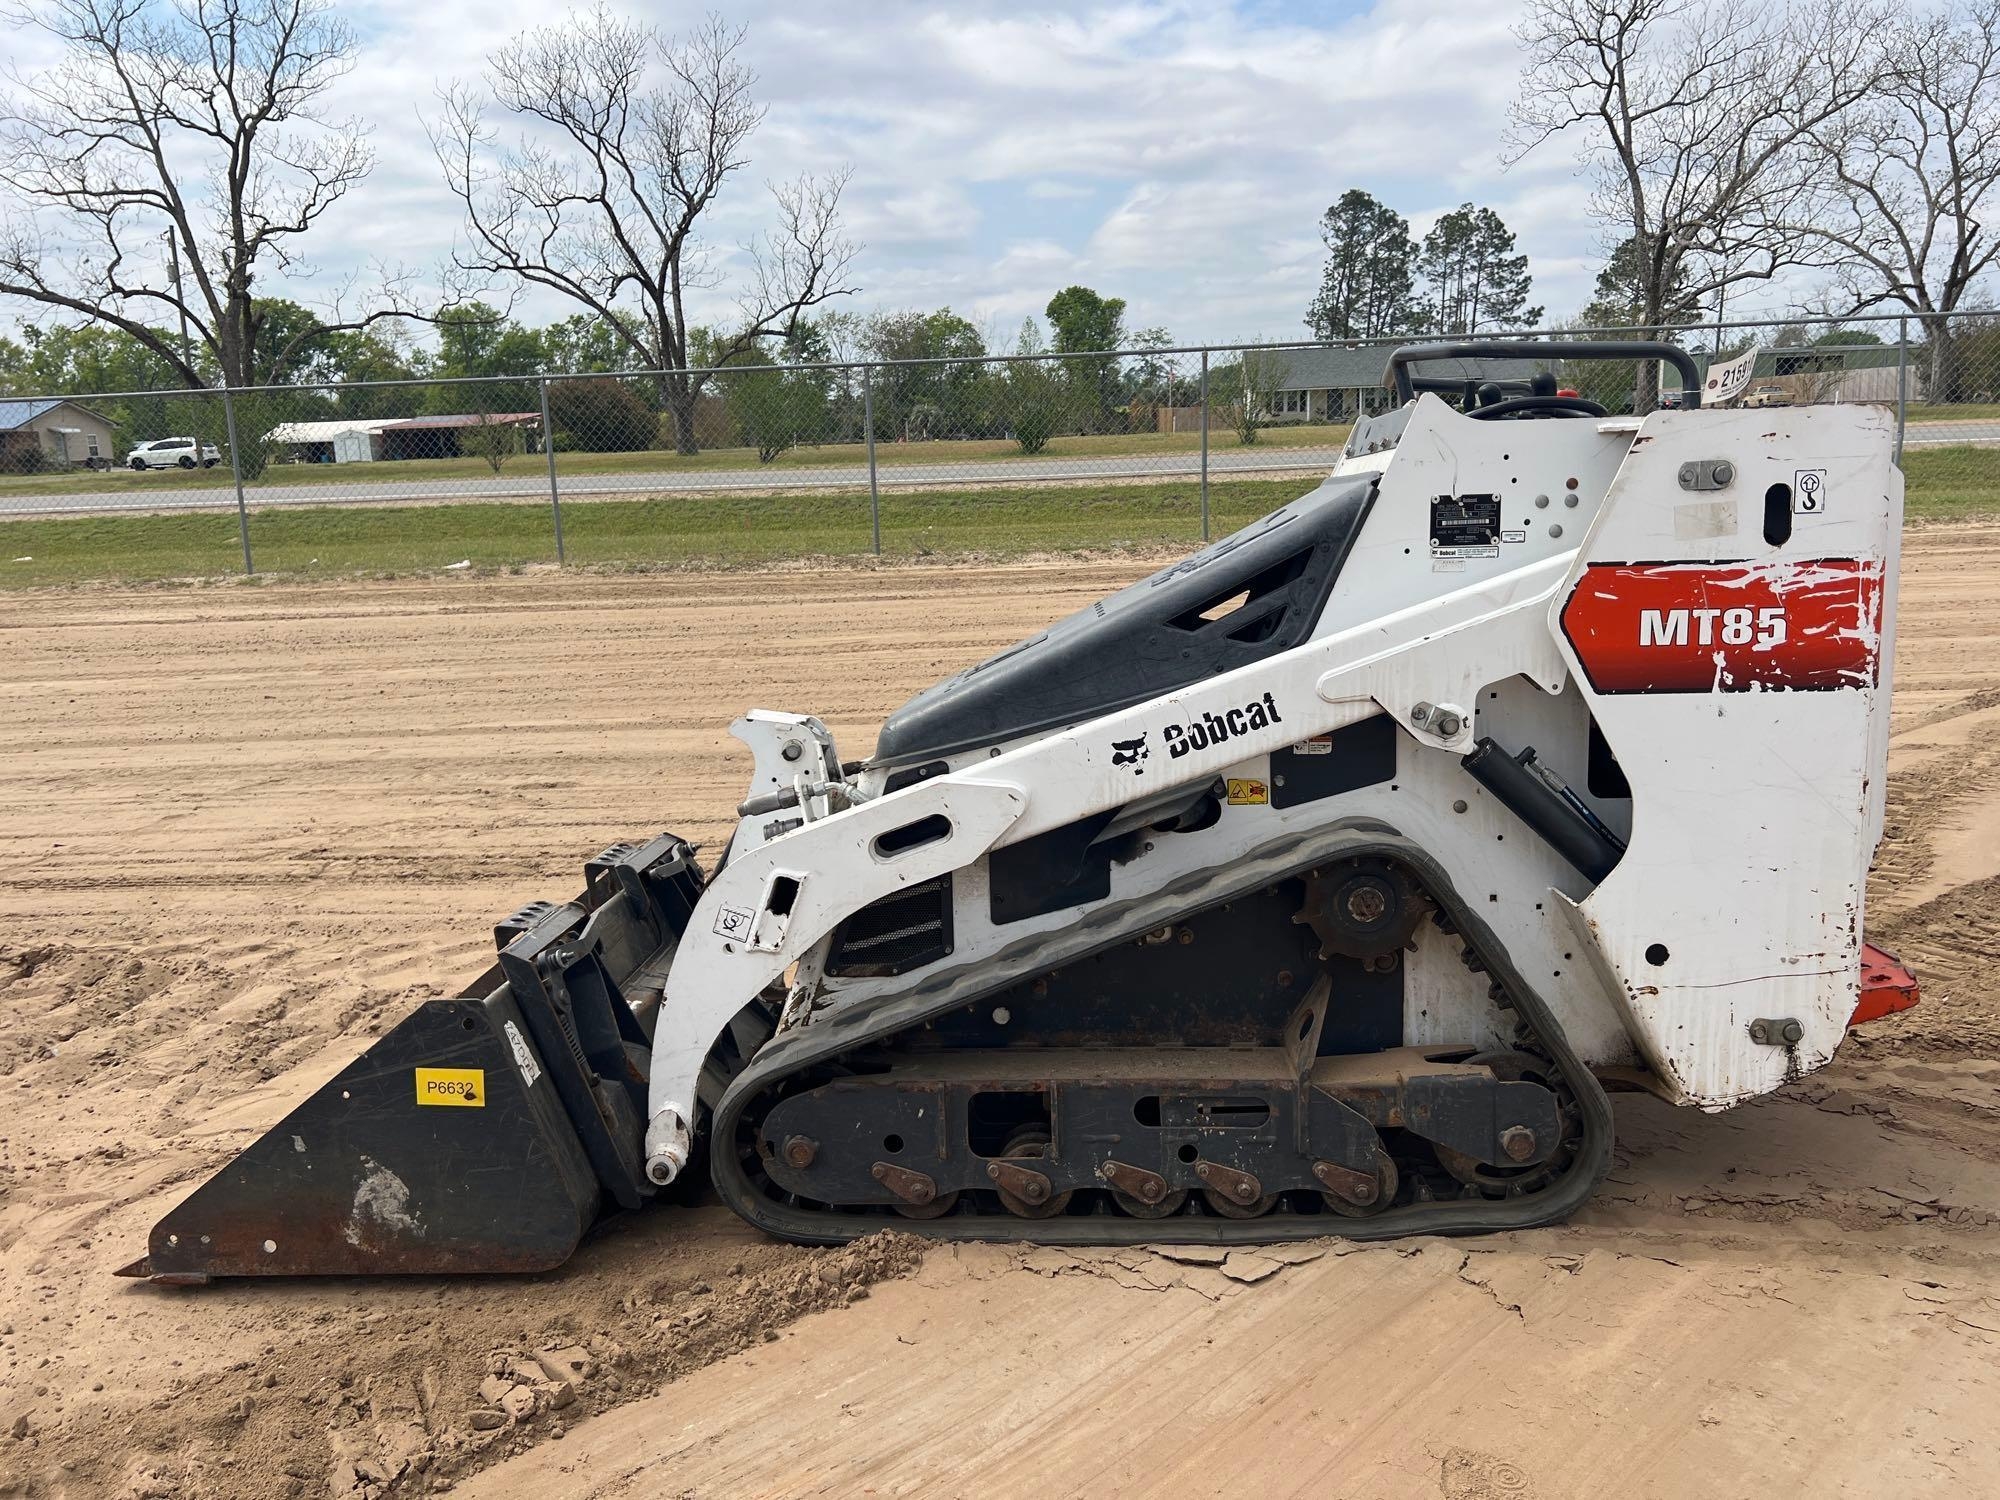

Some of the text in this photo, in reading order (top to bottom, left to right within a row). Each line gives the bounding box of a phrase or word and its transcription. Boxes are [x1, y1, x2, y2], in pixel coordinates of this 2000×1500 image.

[1639, 608, 1787, 647] MT85
[1162, 692, 1282, 759] Bobcat
[428, 1081, 474, 1094] P6632
